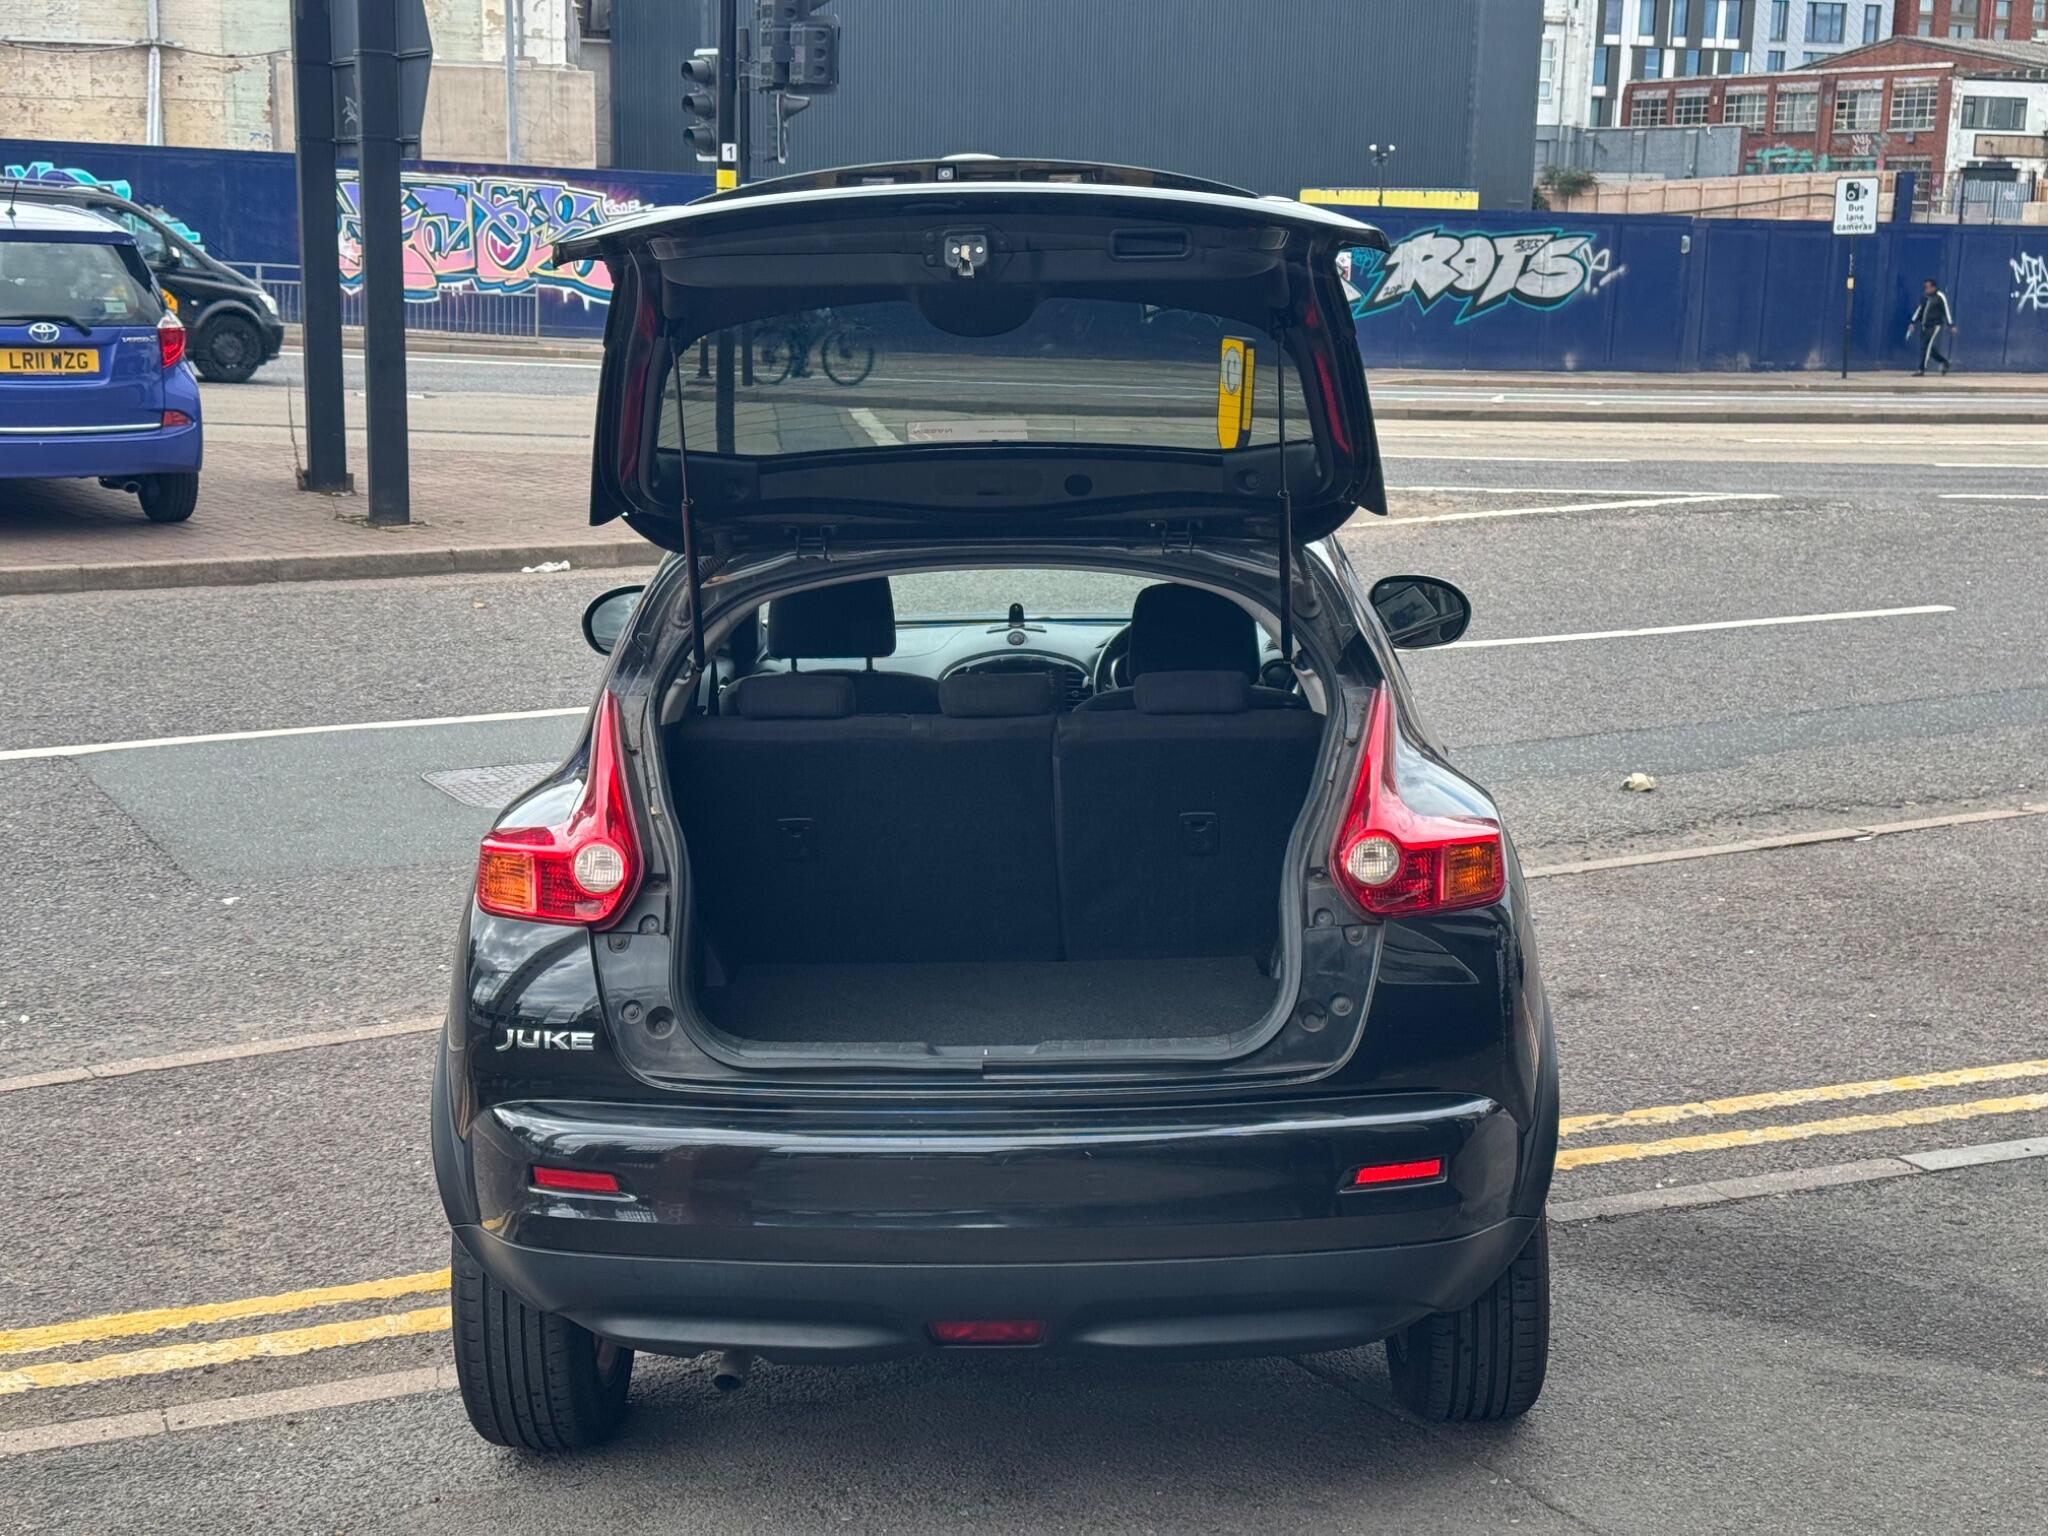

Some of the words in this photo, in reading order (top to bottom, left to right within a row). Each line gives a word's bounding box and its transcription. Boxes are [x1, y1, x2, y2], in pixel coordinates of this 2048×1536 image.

[727, 145, 734, 160] 1
[1848, 203, 1864, 212] Bus
[1846, 213, 1865, 221] lane
[1836, 223, 1873, 231] cameras
[1374, 231, 1592, 306] ROTS
[9, 352, 45, 370] LR11
[51, 351, 89, 370] WZG
[495, 1028, 596, 1052] JUKE
